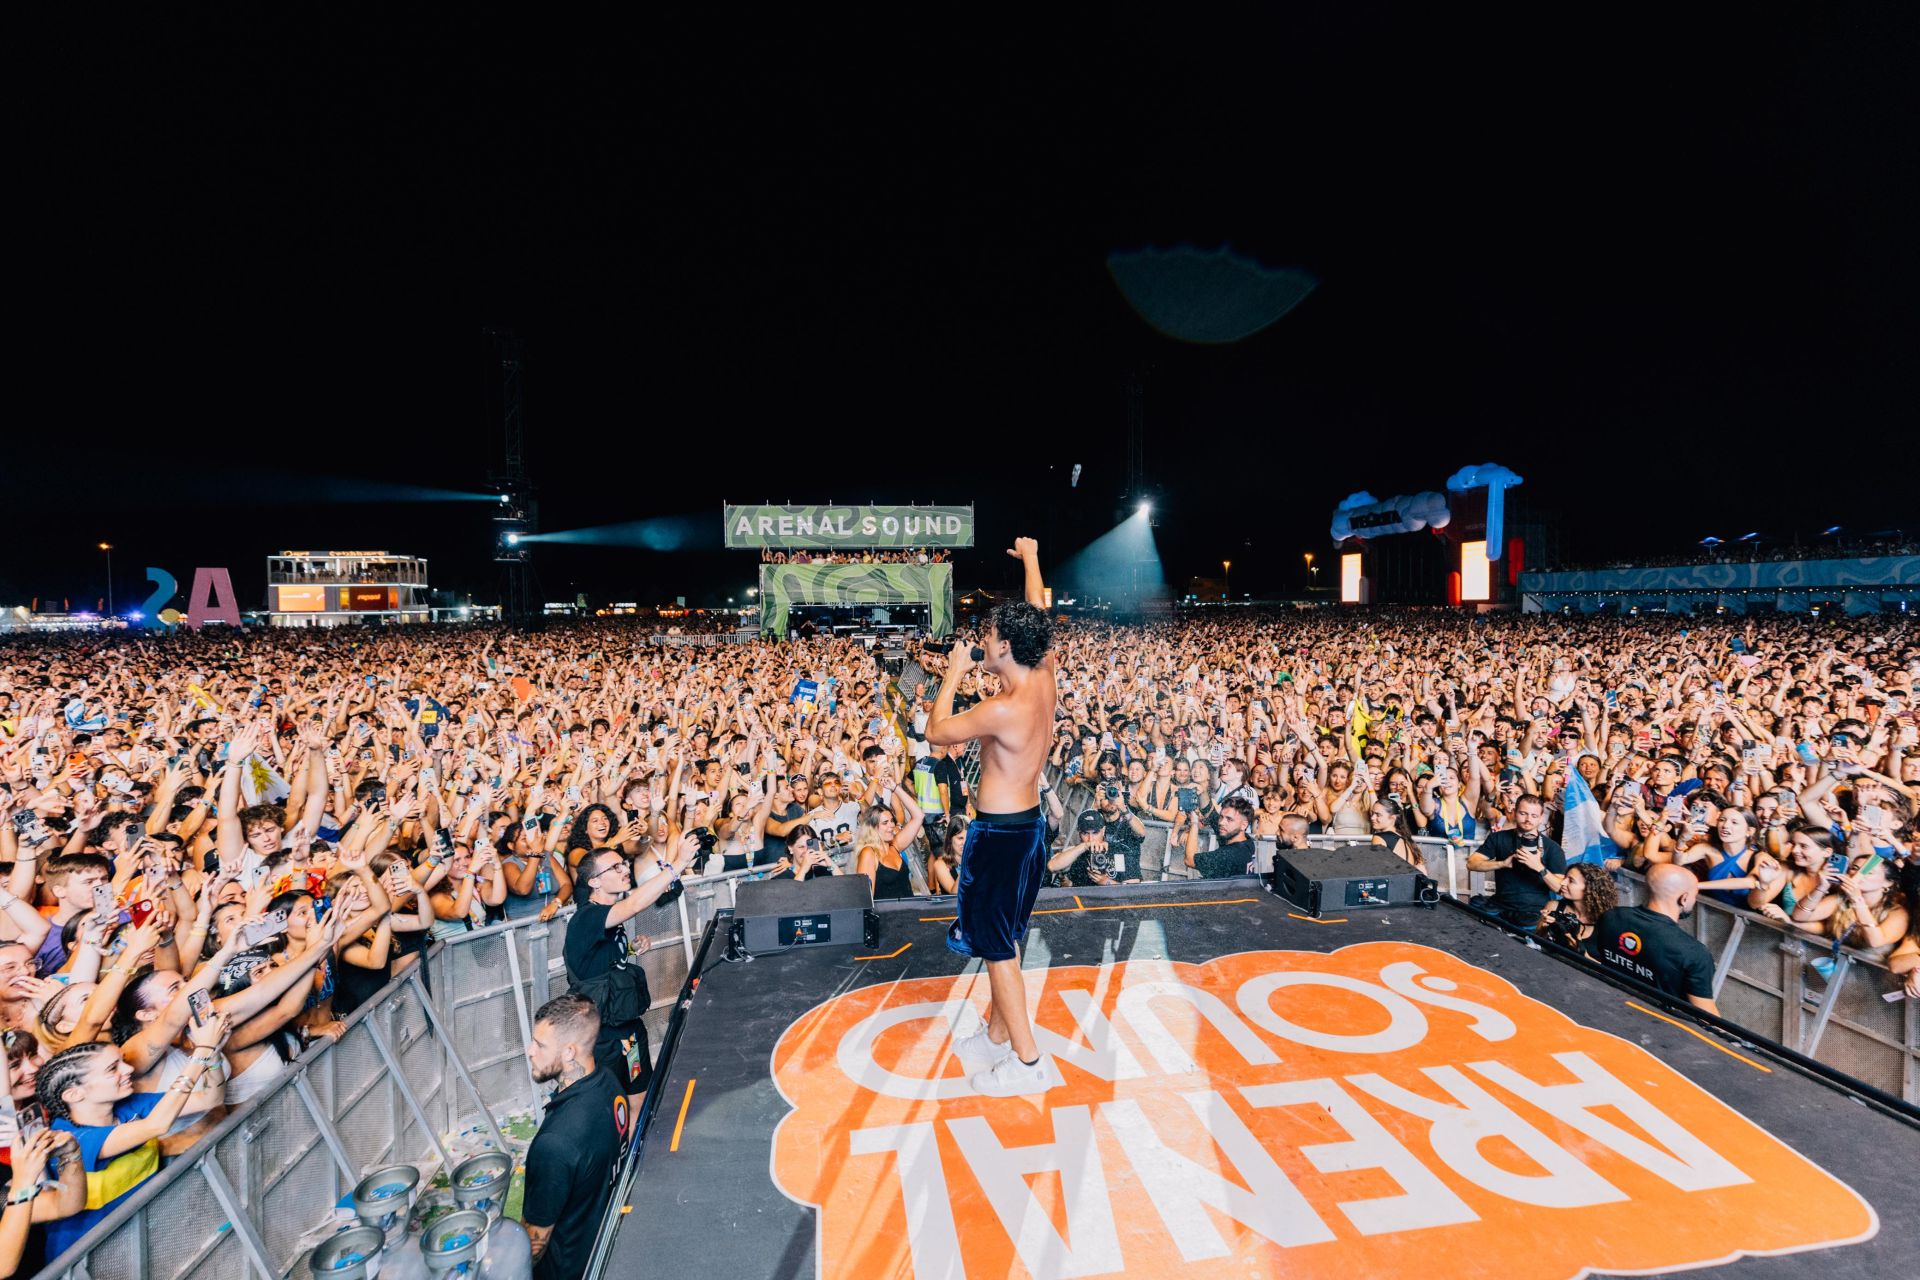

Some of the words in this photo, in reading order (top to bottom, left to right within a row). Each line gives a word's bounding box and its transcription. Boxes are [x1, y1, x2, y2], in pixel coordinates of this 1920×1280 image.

[735, 516, 853, 536] ARENAL
[862, 516, 962, 536] SOUND
[1604, 949, 1634, 971] ELITE
[1636, 963, 1654, 981] NR
[836, 961, 1517, 1101] SOUND
[849, 1051, 1753, 1280] ARENAL
